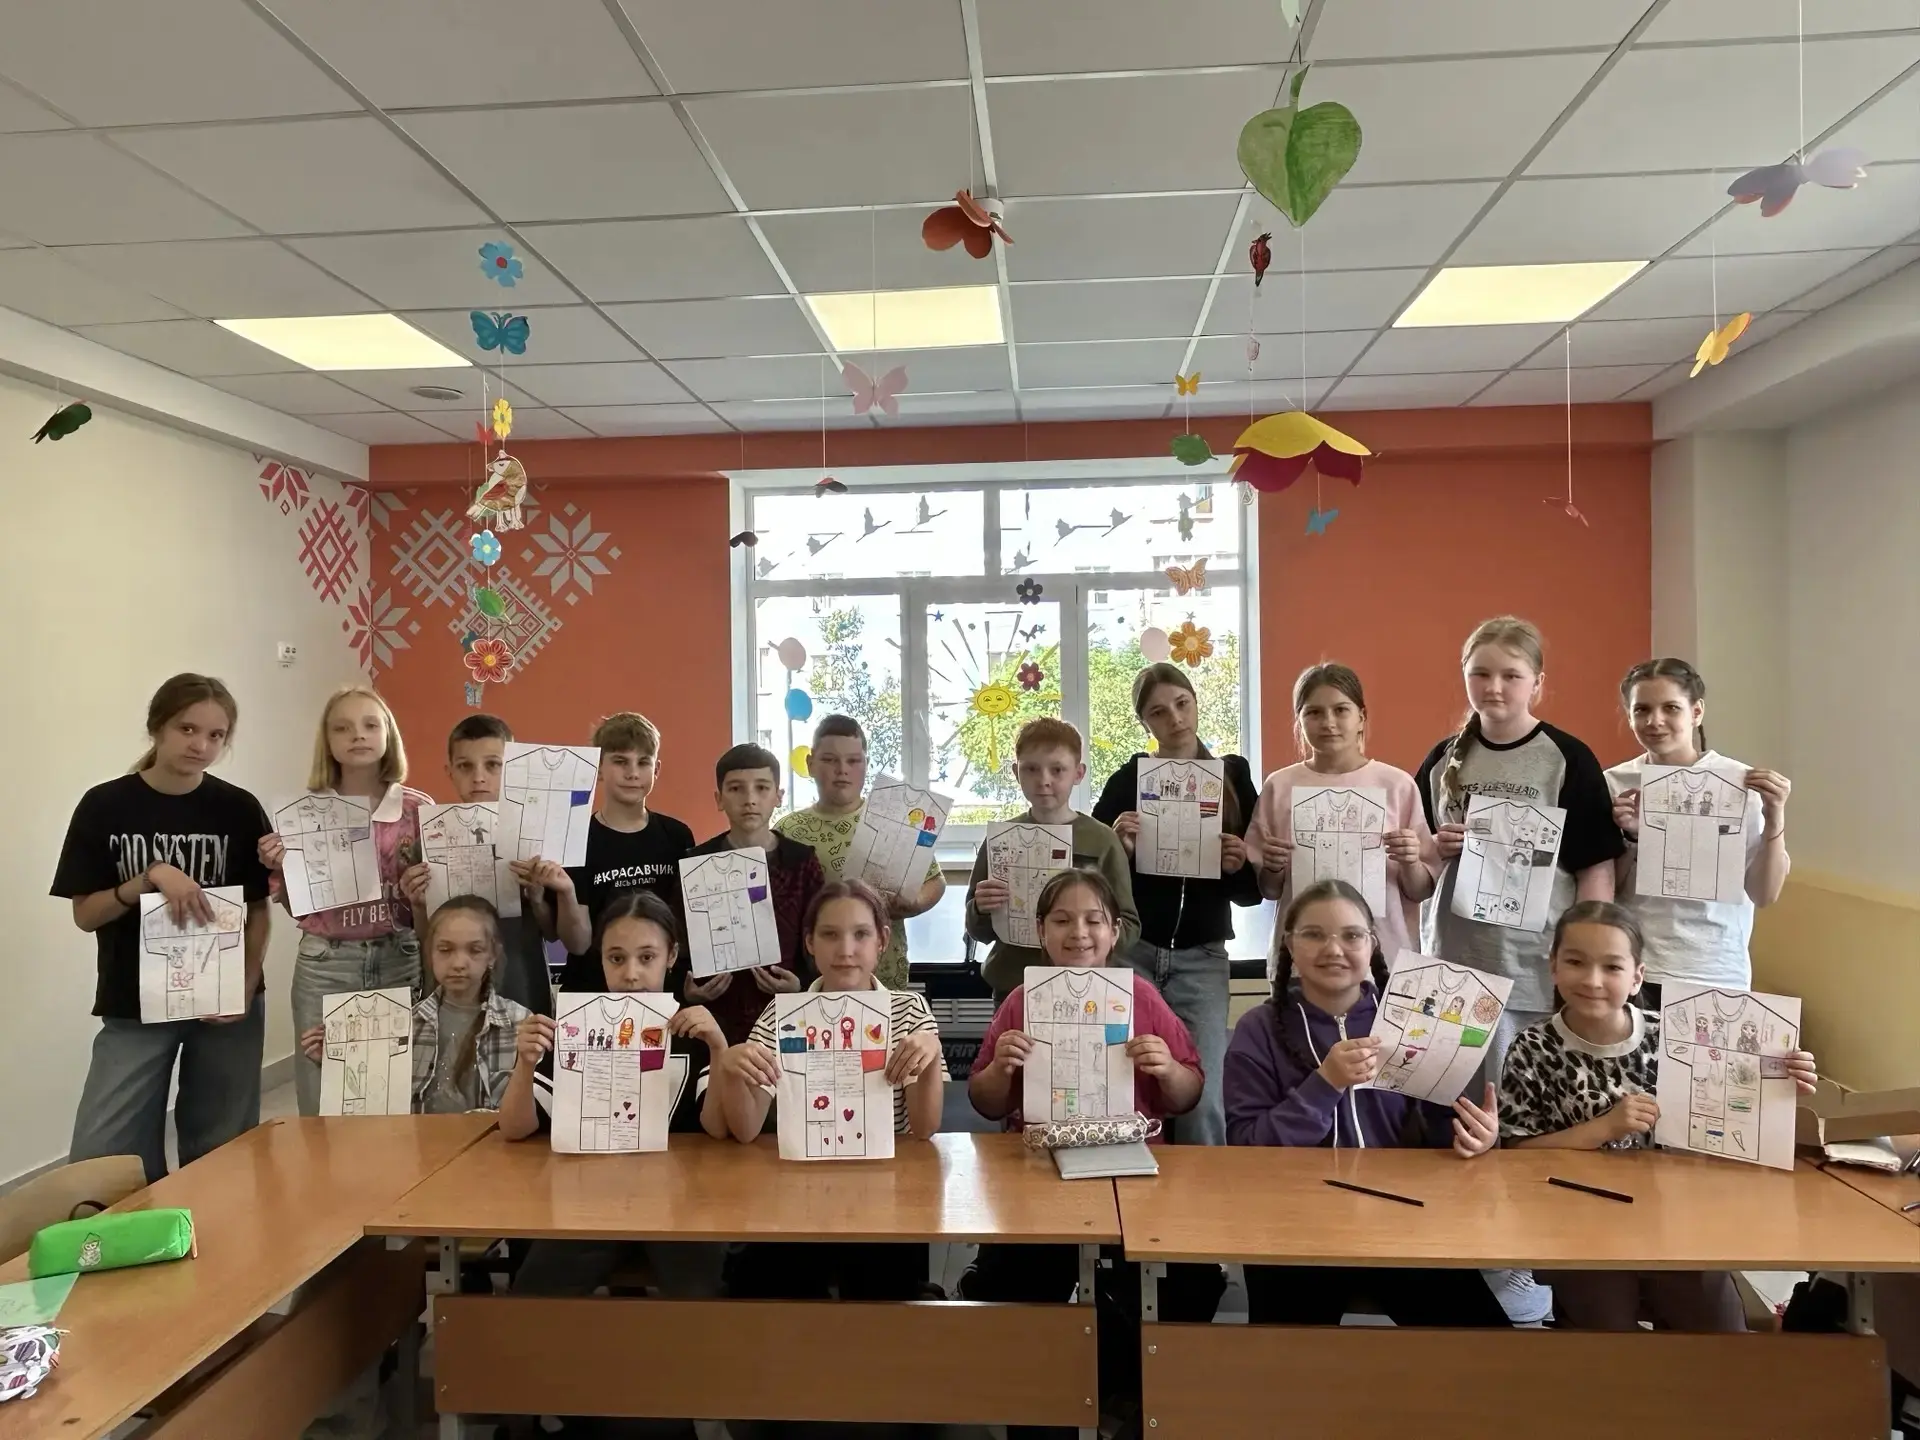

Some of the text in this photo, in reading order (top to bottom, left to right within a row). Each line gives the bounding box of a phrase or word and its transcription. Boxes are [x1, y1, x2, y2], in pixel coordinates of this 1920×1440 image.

[152, 832, 229, 886] SYSTEM
[593, 864, 674, 885] #КРАСАВЧИК
[343, 906, 365, 928] FLY
